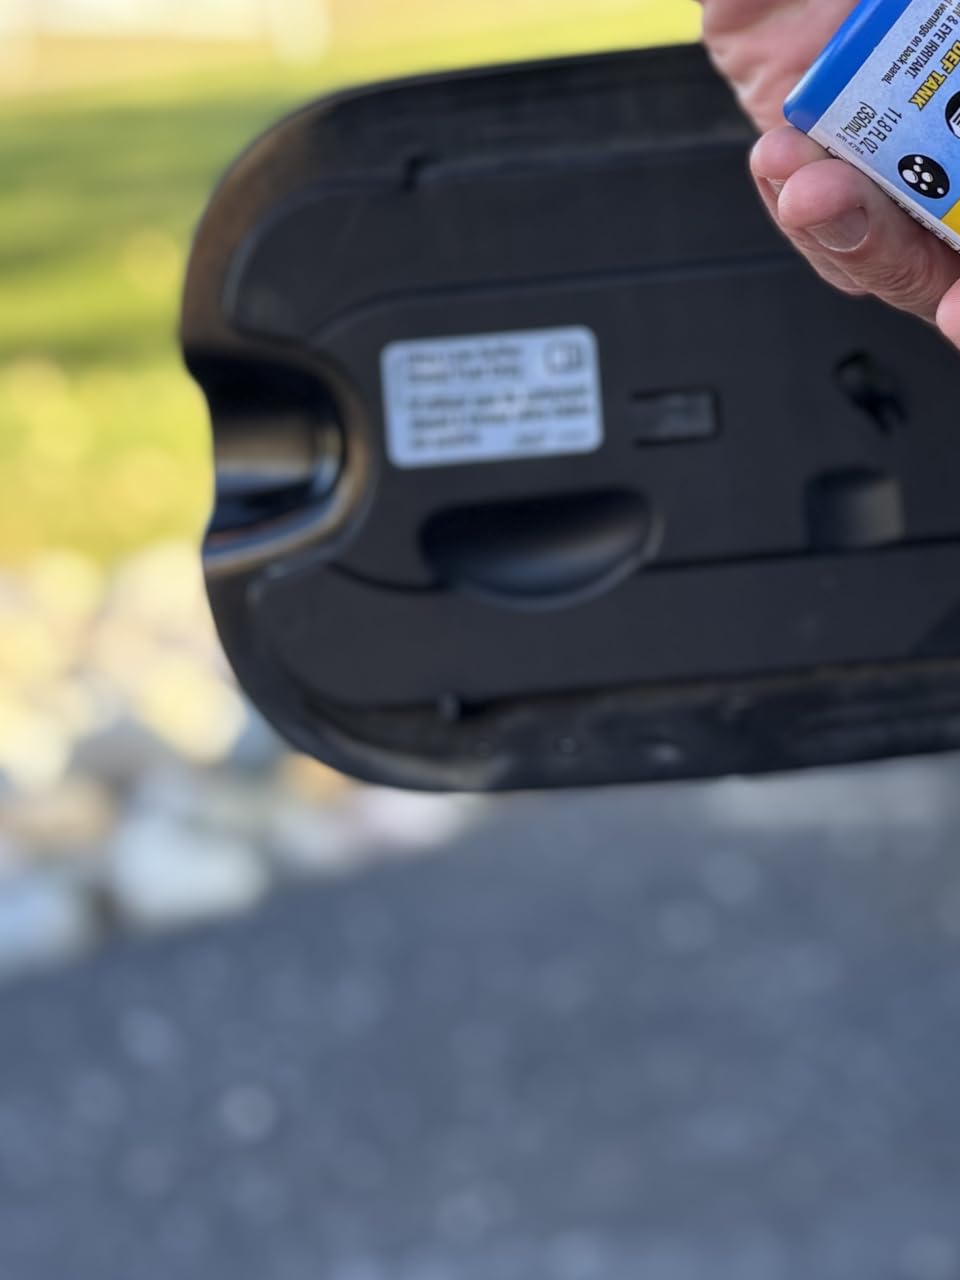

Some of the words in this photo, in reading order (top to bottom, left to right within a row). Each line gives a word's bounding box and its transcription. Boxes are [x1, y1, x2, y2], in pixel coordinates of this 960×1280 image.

[915, 0, 949, 38] warnings
[944, 13, 959, 27] &
[909, 34, 922, 47] on
[932, 21, 953, 43] EYE
[896, 44, 916, 66] back
[907, 67, 947, 111] TANK
[838, 99, 879, 142] (350mL)
[875, 105, 903, 134] 11.8
[857, 135, 879, 154] OZ
[866, 125, 887, 145] FL
